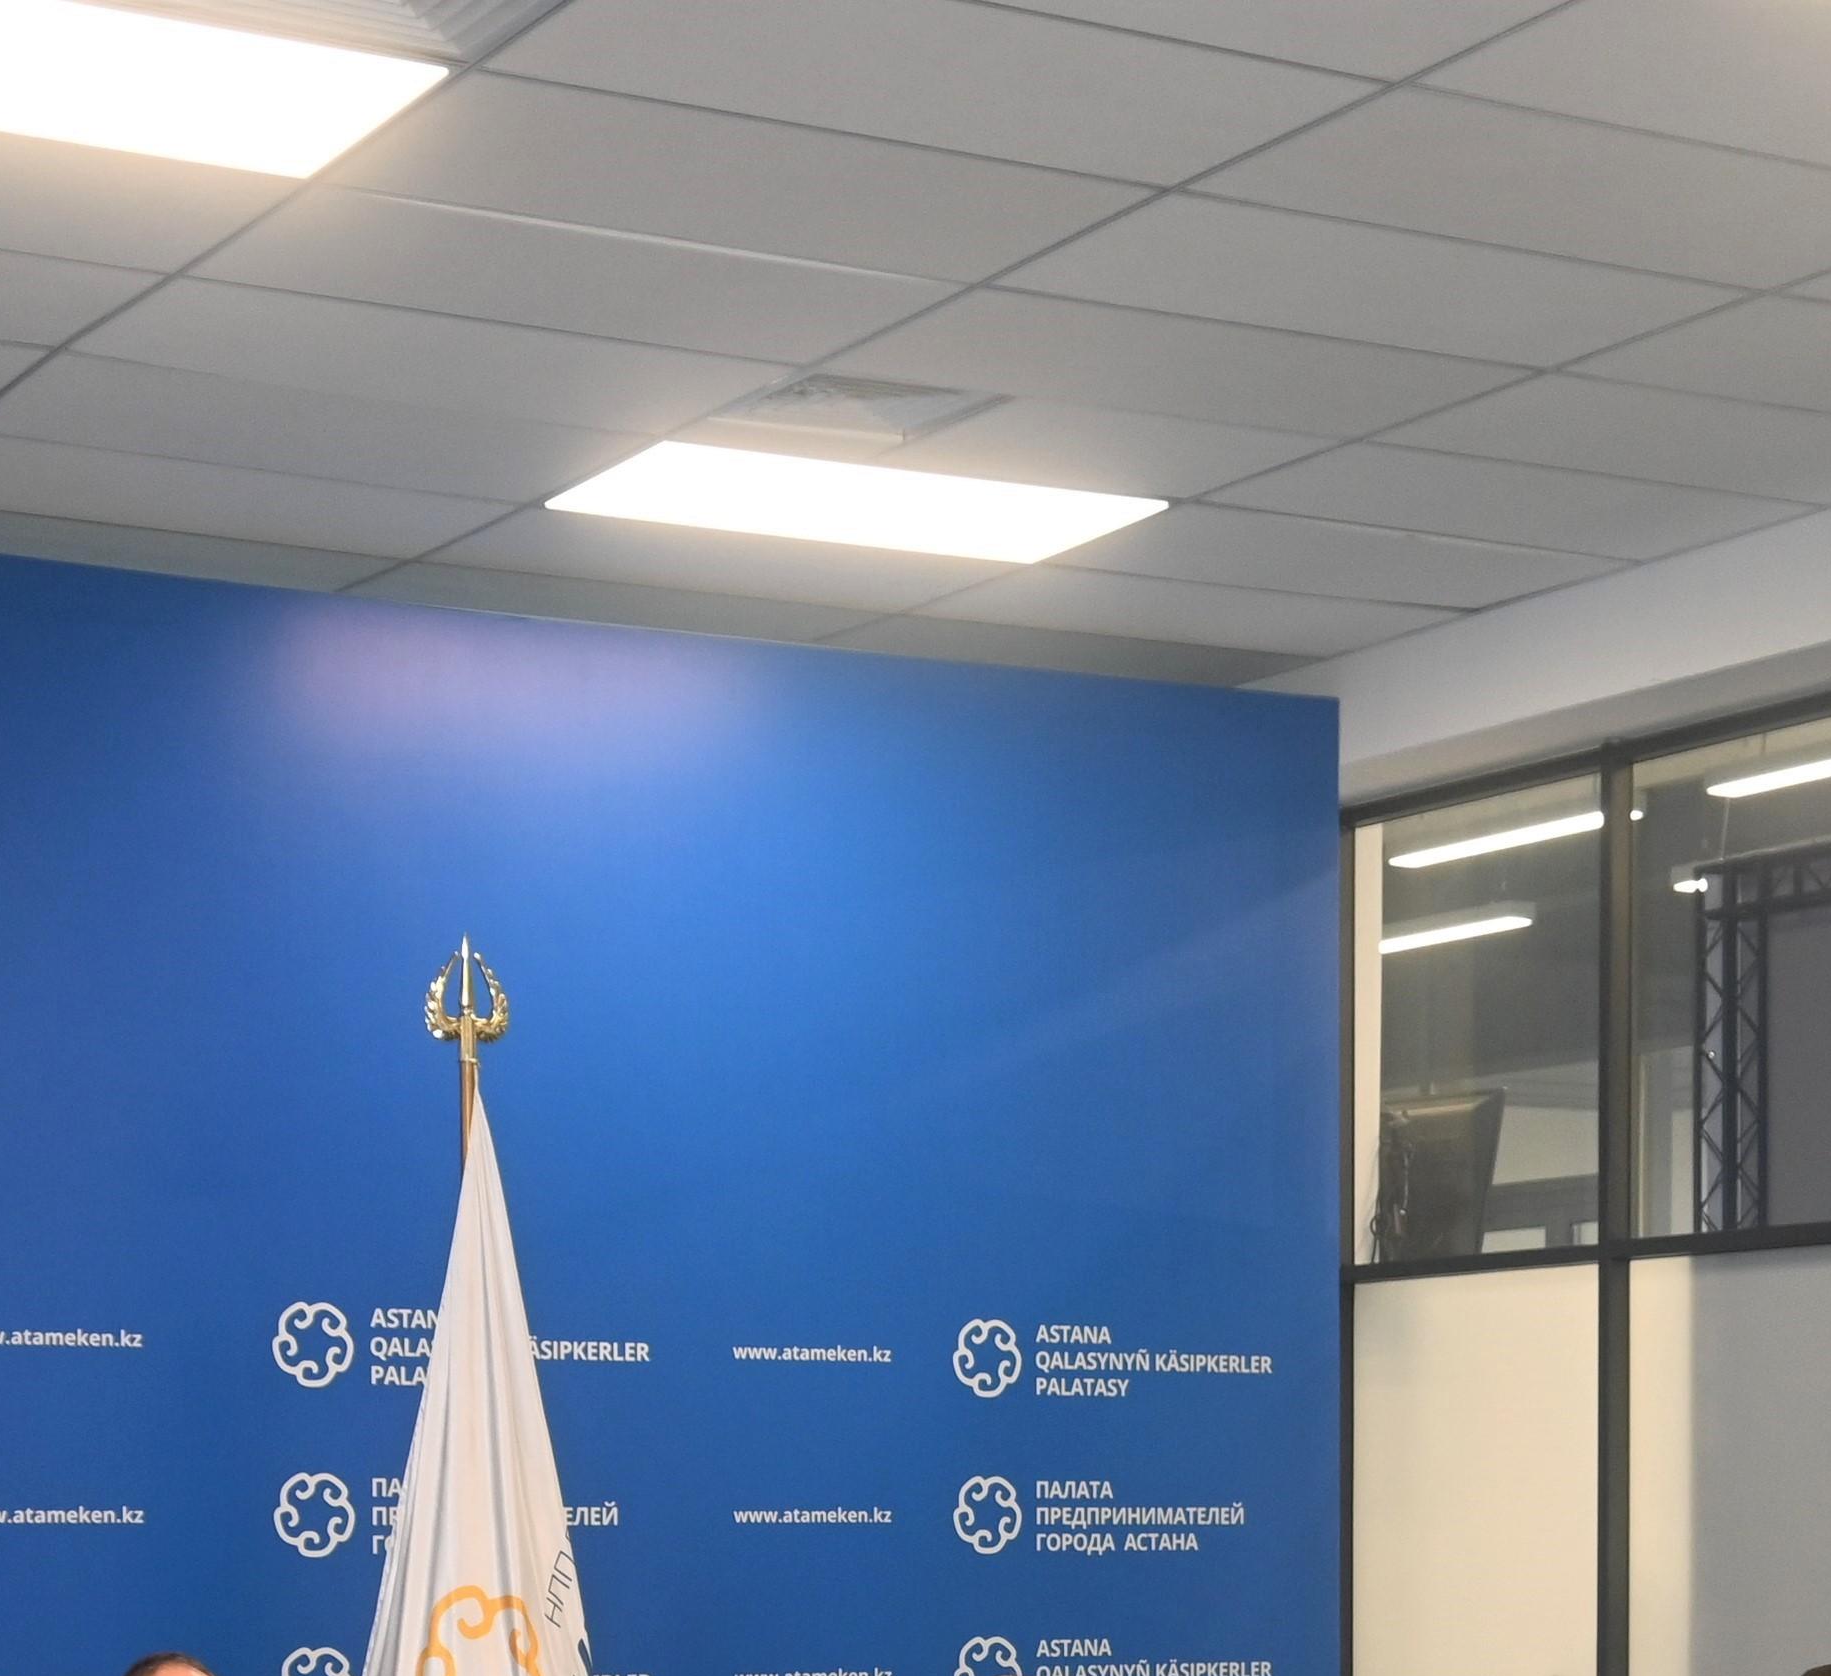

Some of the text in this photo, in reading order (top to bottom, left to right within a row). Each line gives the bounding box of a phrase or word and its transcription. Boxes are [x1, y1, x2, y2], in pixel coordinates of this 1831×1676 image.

[371, 1308, 439, 1328] ASTAN
[1036, 1325, 1111, 1344] ASTANA
[530, 1336, 650, 1362] ÄSIPKERLER
[733, 1345, 891, 1362] www.atameken.kz
[1036, 1349, 1272, 1373] QALASYNYÑ KÄSIPKERLER
[1036, 1377, 1129, 1397] PALATASY
[1037, 1481, 1113, 1499] ПАЛАТА
[734, 1507, 891, 1523] www.atameken.kz
[1037, 1503, 1244, 1529] ПРЕДПРИНИМАТЕЛЕЙ
[1037, 1533, 1198, 1555] ГОРОДА АСТАНА
[1037, 1639, 1111, 1657] ASTANA
